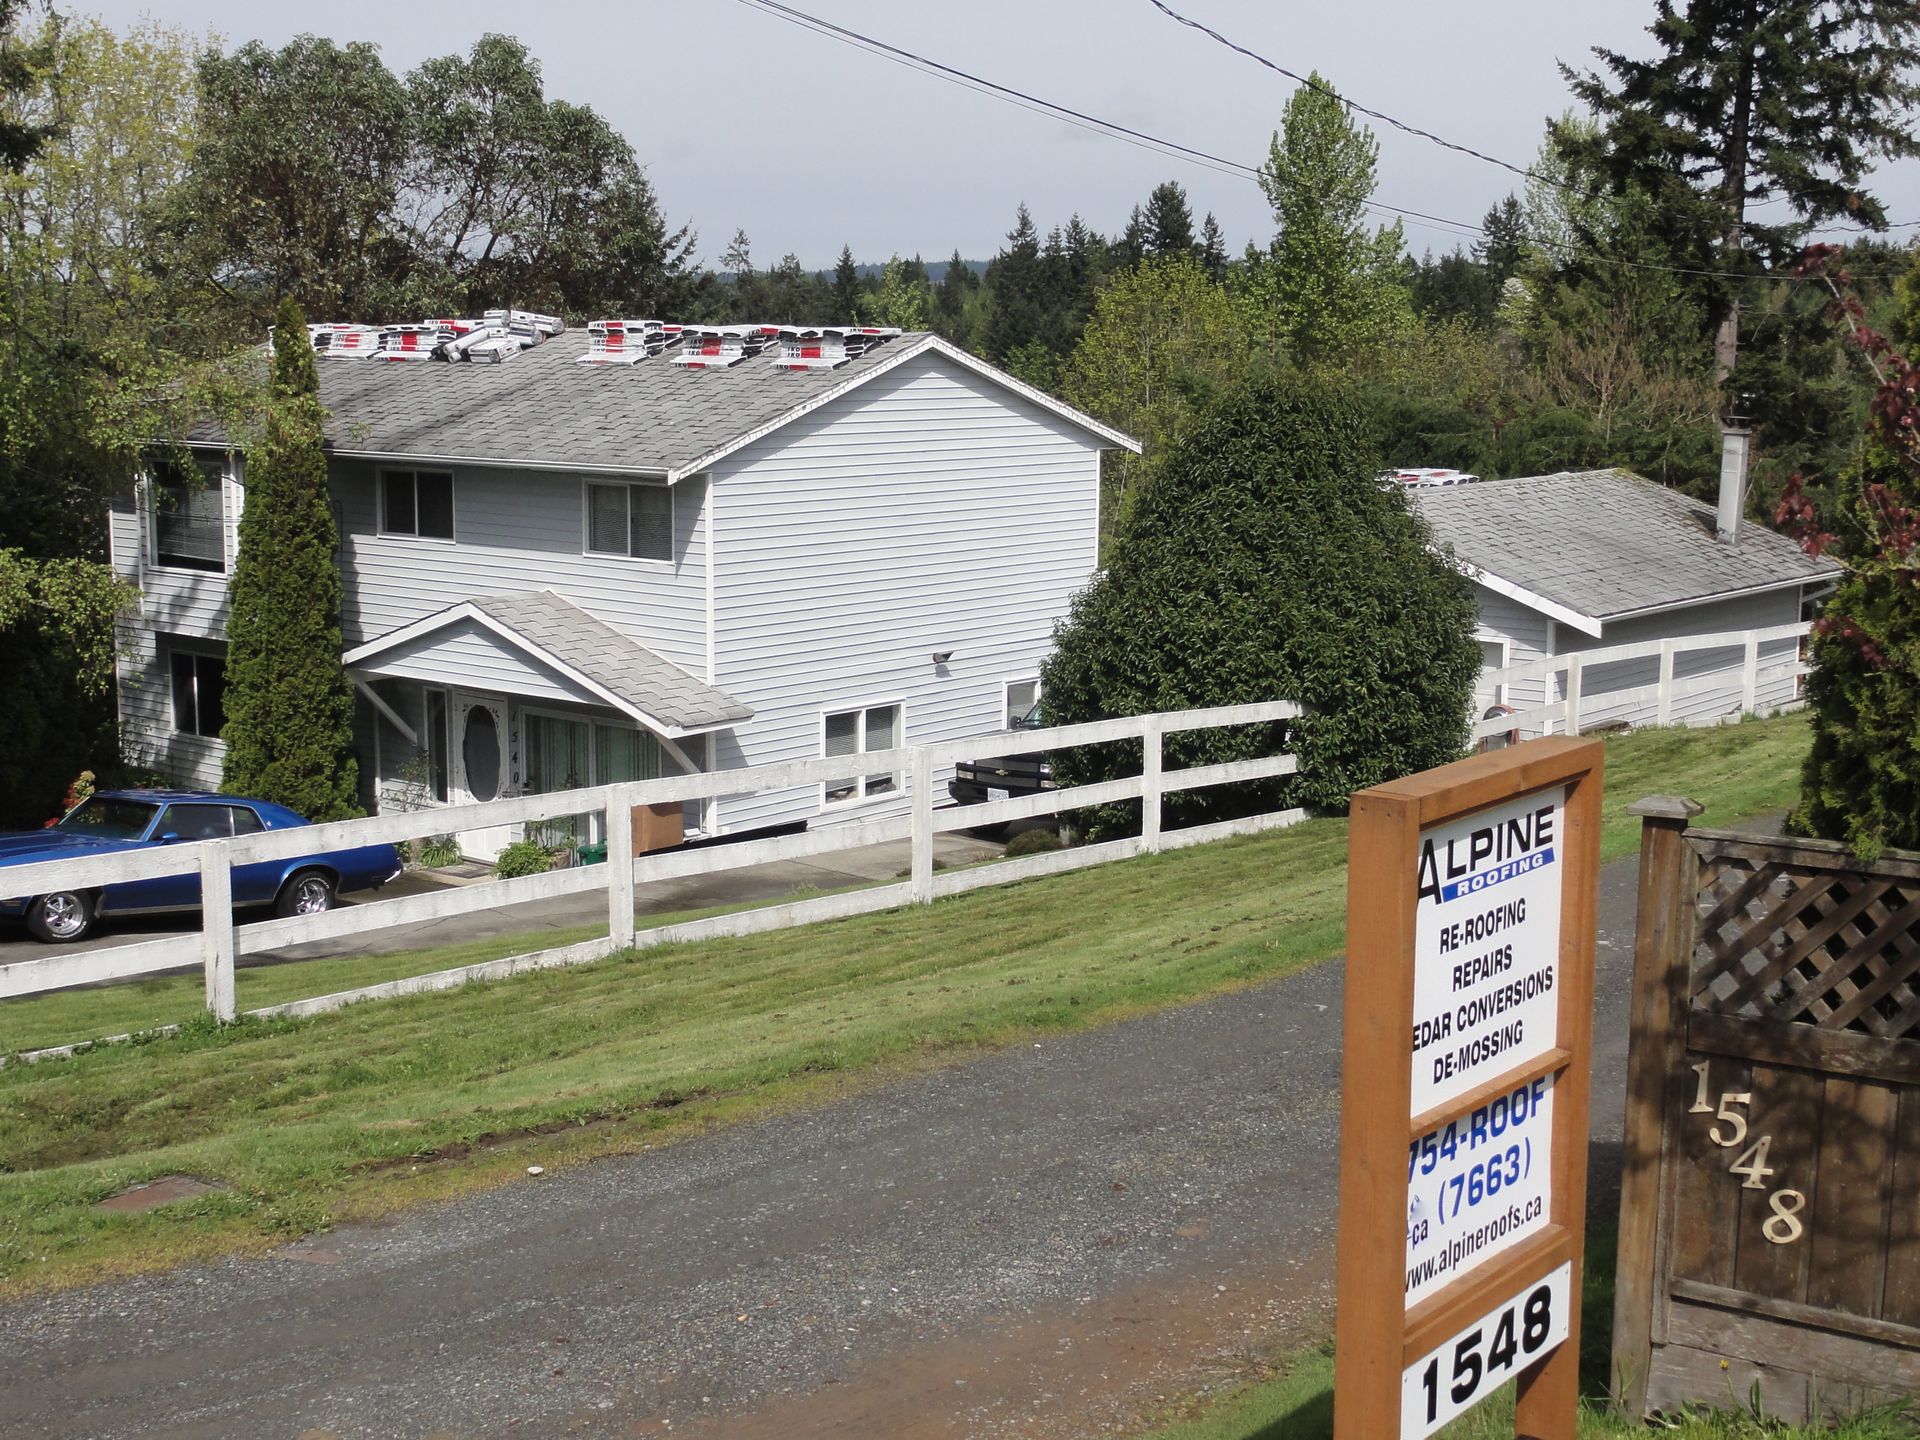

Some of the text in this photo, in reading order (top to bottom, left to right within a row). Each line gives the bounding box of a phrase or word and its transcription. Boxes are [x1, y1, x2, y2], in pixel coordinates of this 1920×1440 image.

[1417, 805, 1555, 905] ALPINE
[1457, 853, 1544, 897] ROOFING
[1440, 897, 1527, 955] RE-ROOFING
[1452, 944, 1513, 992] REPAIRS
[1413, 965, 1553, 1052] EDAR CONVERSIONS
[1433, 1019, 1524, 1085] DE-MOSSING
[1438, 1136, 1531, 1225] (7663)
[1688, 1060, 1806, 1244] 1548
[1423, 1284, 1552, 1425] 1548
